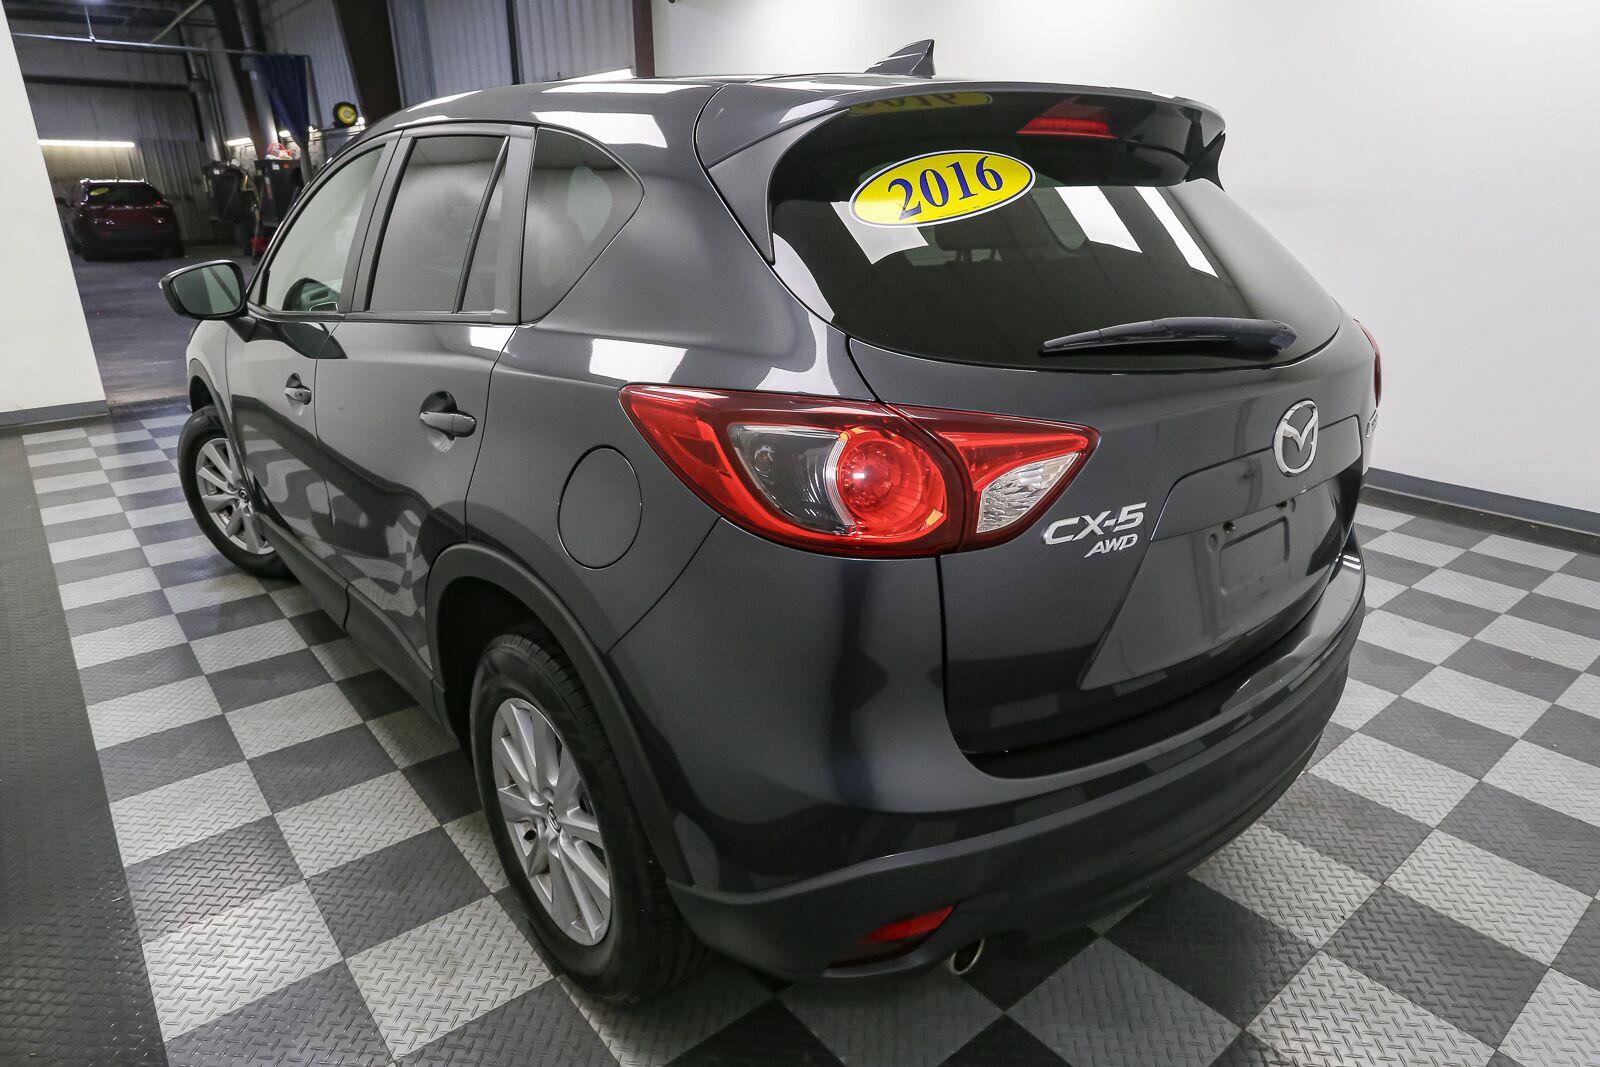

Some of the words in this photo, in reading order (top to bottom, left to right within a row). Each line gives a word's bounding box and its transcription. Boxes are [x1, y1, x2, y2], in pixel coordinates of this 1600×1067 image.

[887, 155, 1003, 220] 2016
[1042, 501, 1148, 545] CX-5
[1083, 533, 1139, 559] AWD
